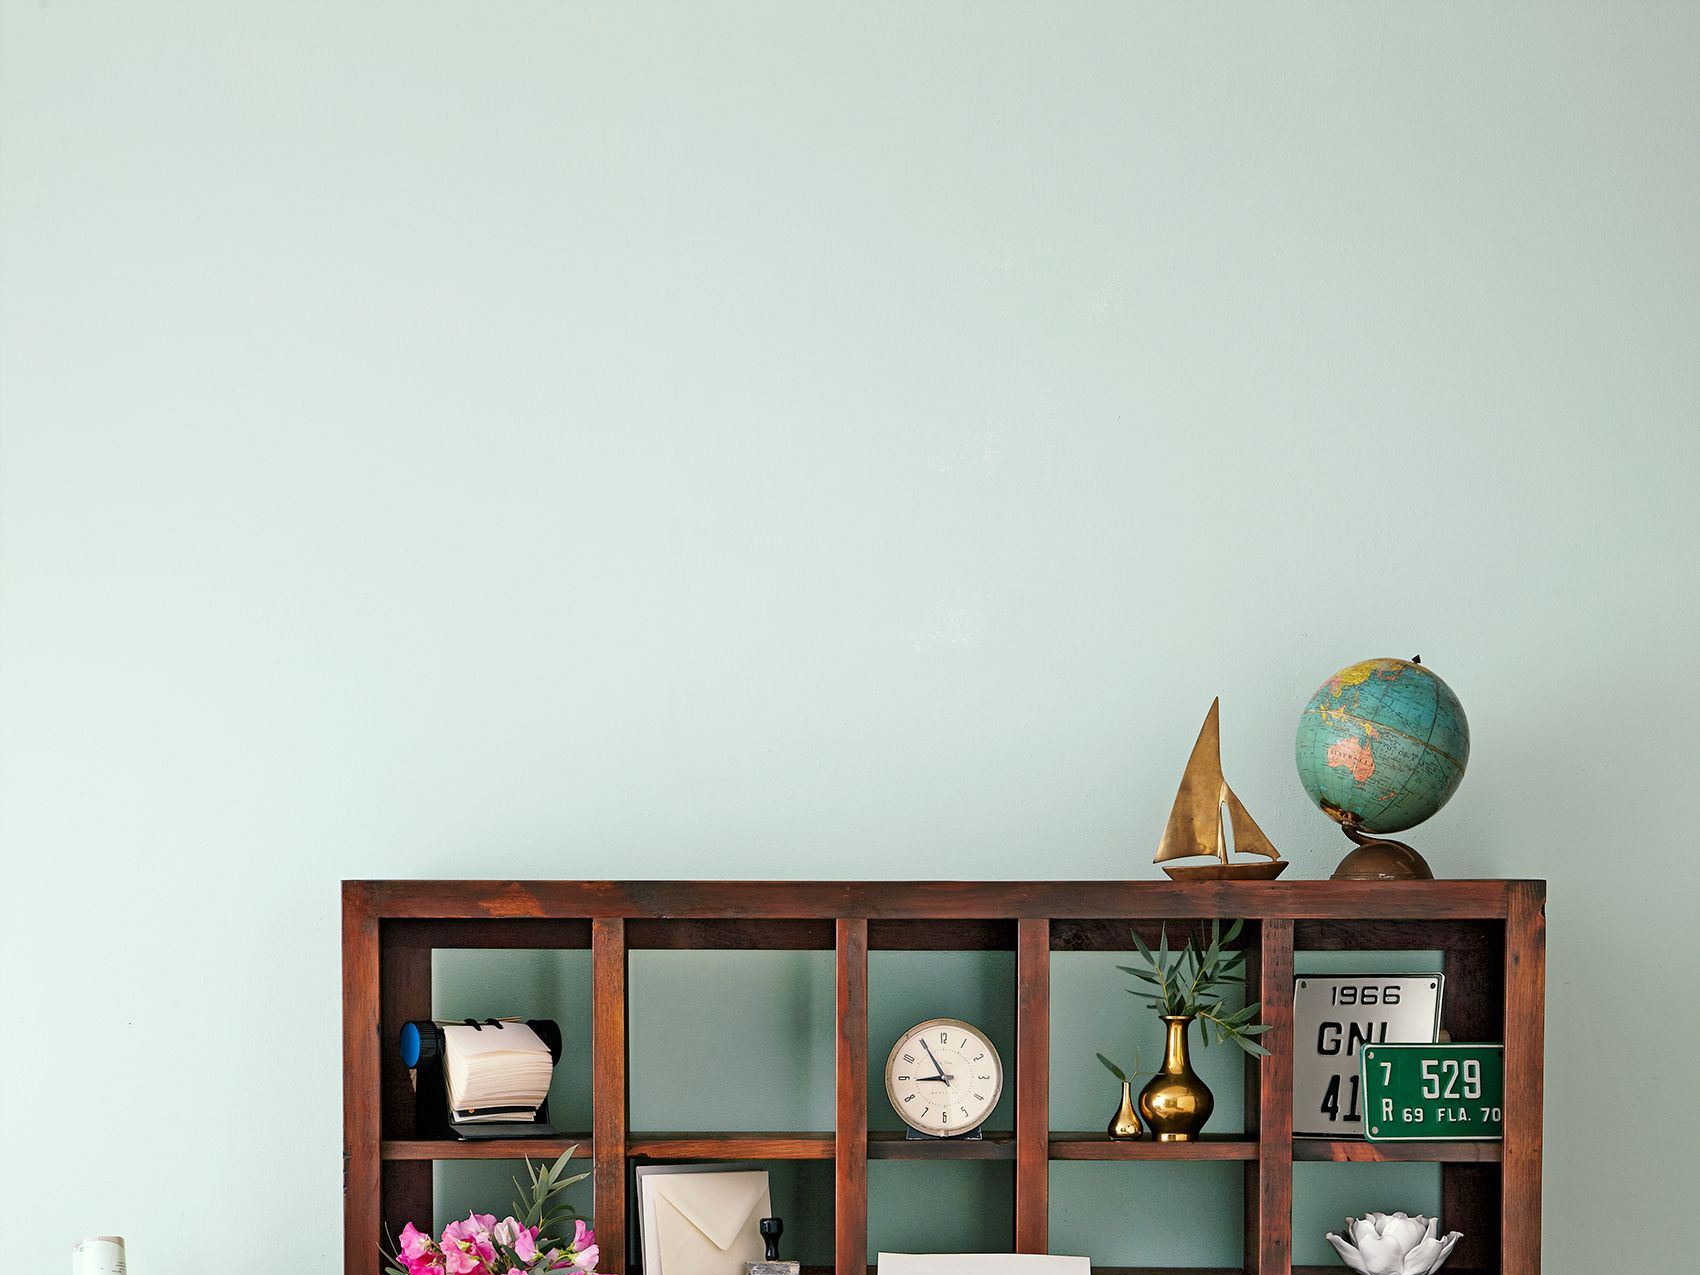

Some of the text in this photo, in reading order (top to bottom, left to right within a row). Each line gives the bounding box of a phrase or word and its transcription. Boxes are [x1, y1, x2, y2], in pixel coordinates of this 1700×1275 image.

[1332, 985, 1401, 1006] 1966
[940, 1032, 947, 1044] 12
[903, 1053, 915, 1064] 10
[973, 1053, 984, 1062] 2
[1380, 1059, 1482, 1099] 7 529
[904, 1094, 915, 1102] 8
[974, 1093, 984, 1101] 4
[921, 1106, 929, 1117] 7
[960, 1106, 969, 1118] 5
[1382, 1098, 1501, 1123] R 69 FLA. 70
[942, 1111, 947, 1124] 6
